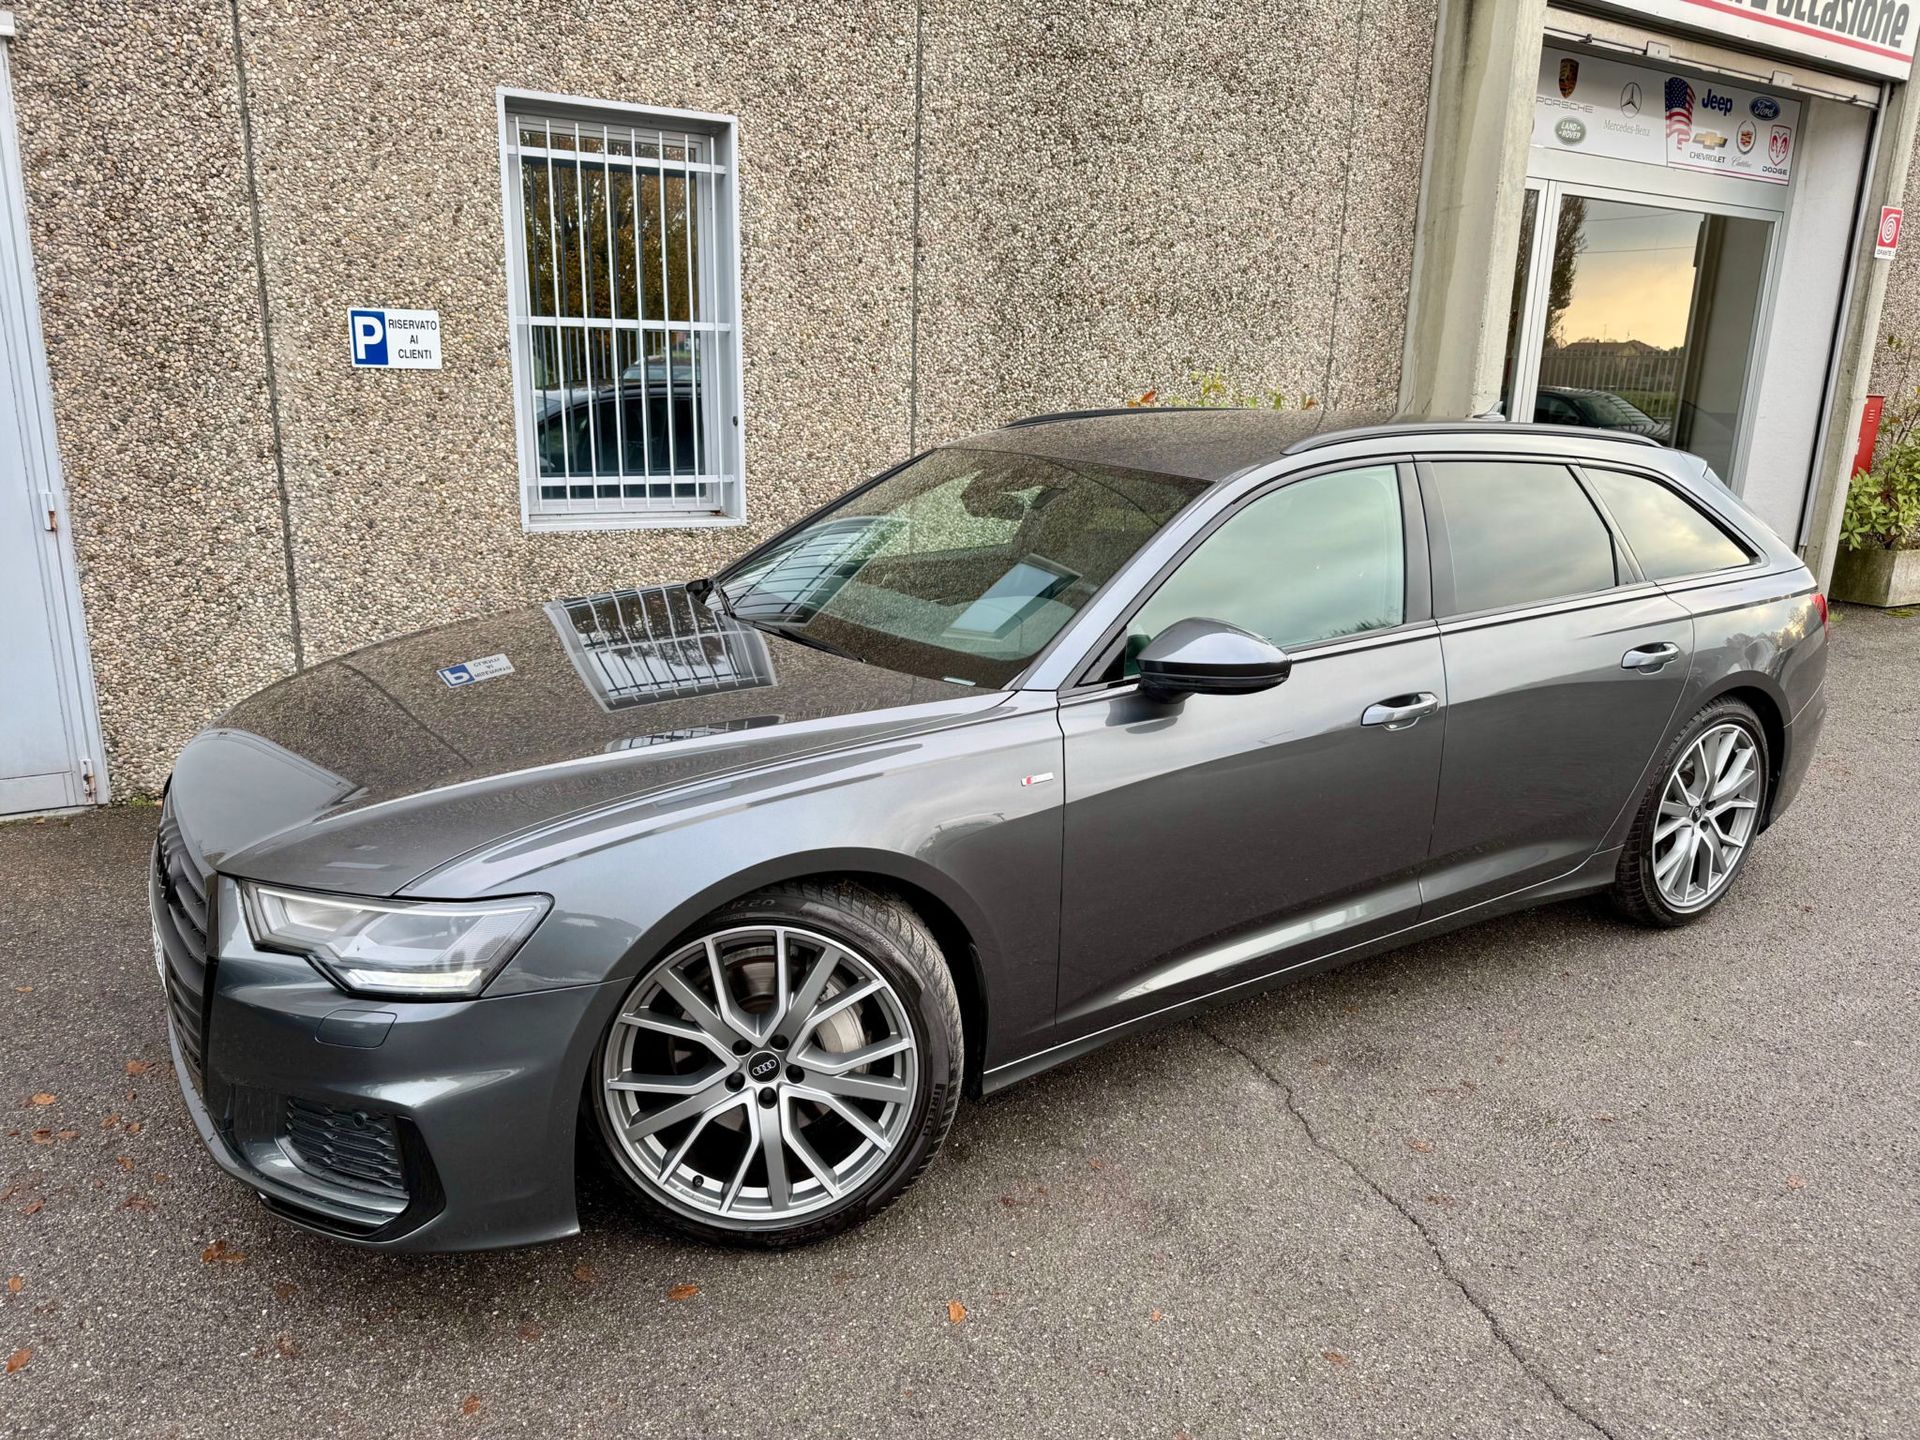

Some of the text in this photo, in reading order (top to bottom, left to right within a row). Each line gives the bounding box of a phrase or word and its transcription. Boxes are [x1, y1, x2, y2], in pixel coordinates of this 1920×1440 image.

[1536, 96, 1594, 114] PORSCHE
[1702, 88, 1733, 116] Jeep
[1754, 99, 1777, 118] Ford
[1561, 121, 1578, 131] LAND
[1562, 129, 1581, 139] ROVER
[1690, 151, 1726, 163] CHEVROLET
[1762, 165, 1788, 176] DODGE
[388, 318, 437, 331] RISERVATO
[353, 316, 384, 360] P
[409, 335, 418, 344] AI
[398, 348, 432, 359] CLIENTI
